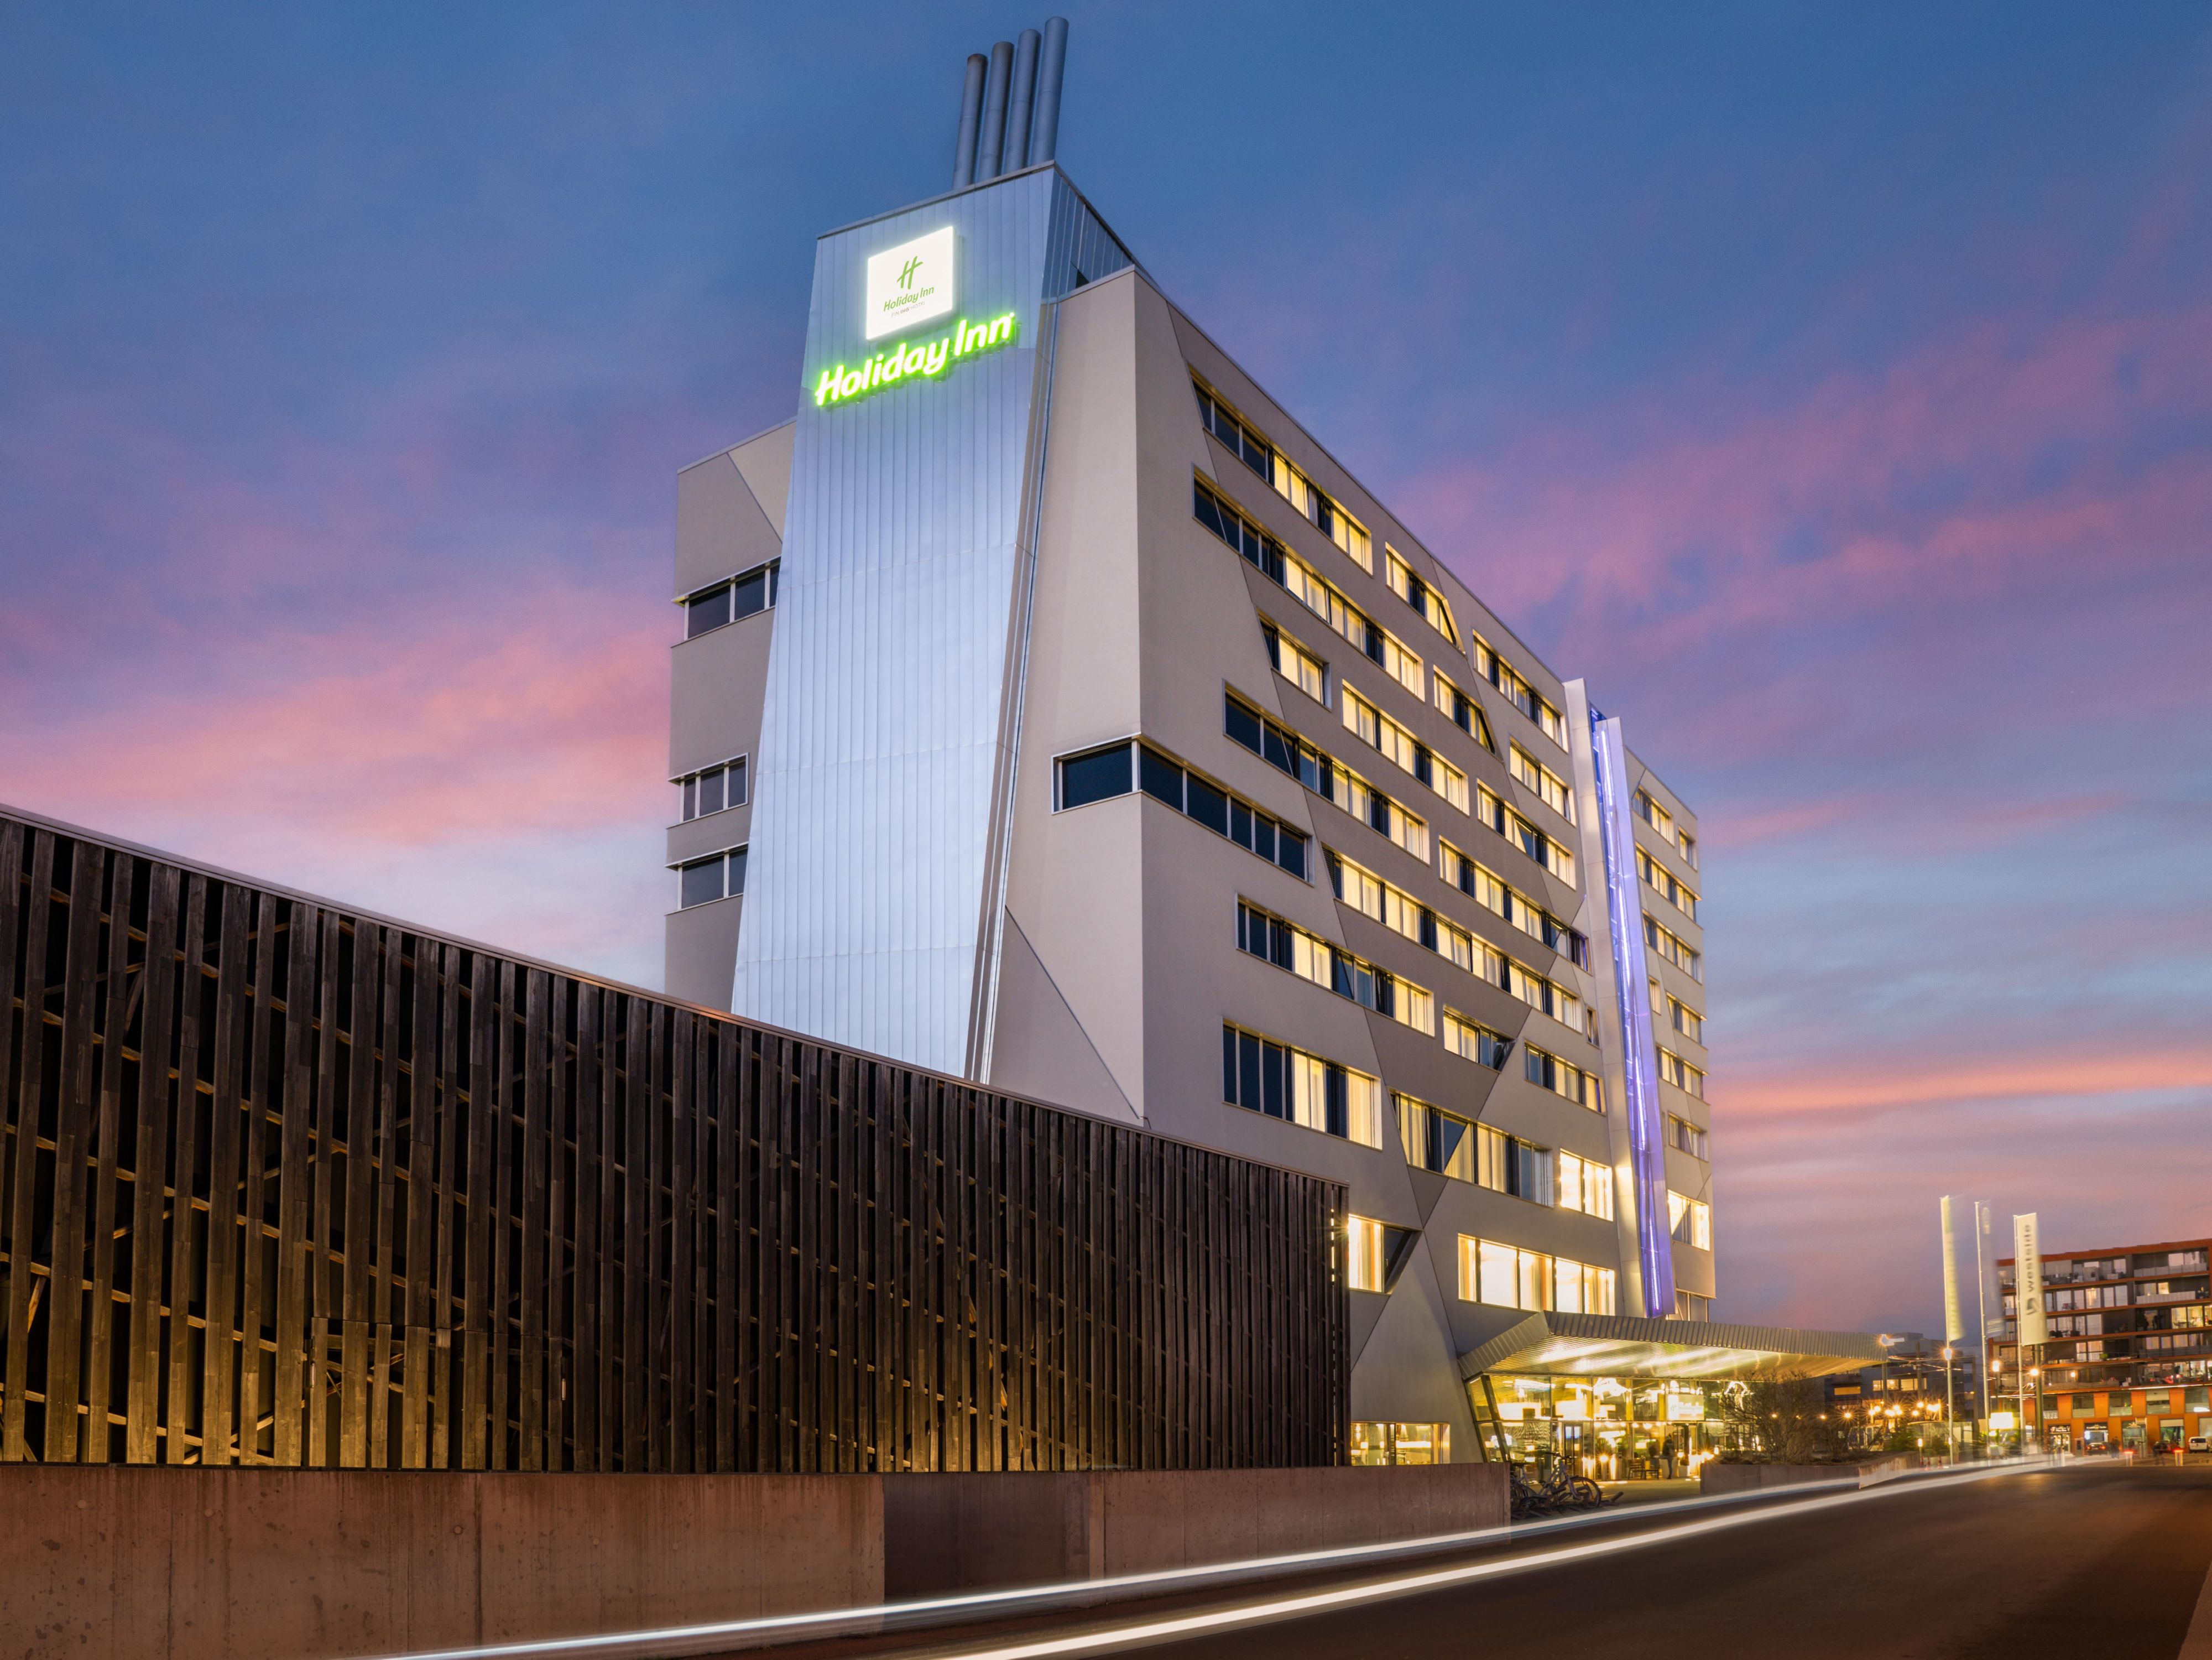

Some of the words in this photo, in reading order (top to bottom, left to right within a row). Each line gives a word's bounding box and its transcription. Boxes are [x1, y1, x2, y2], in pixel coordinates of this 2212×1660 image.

[884, 292, 919, 311] Holiday
[920, 287, 935, 298] Inn
[815, 337, 950, 406] Holiday
[953, 312, 1014, 356] Inn
